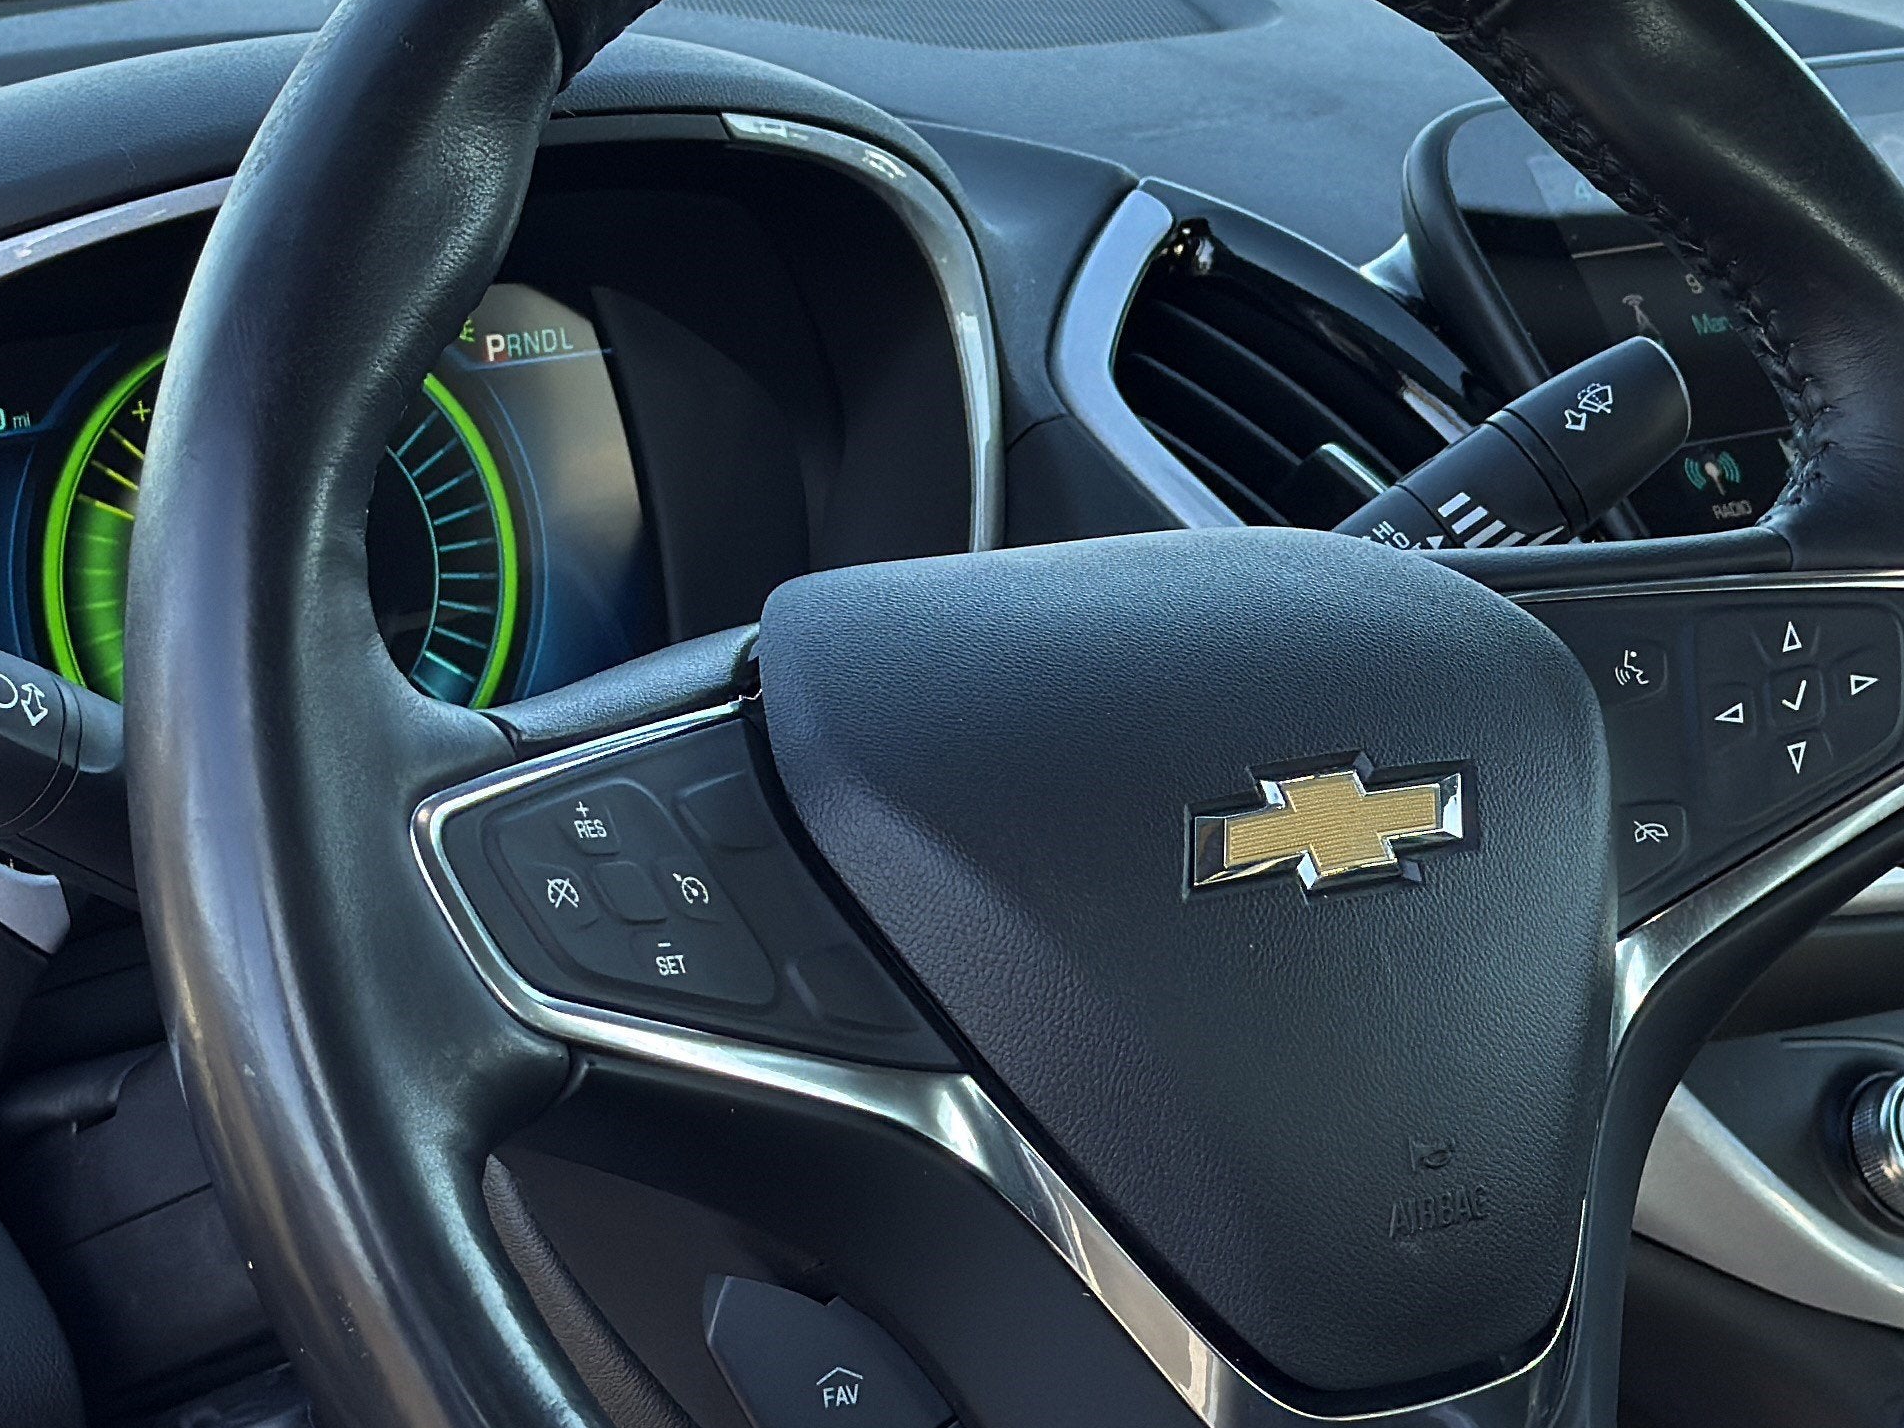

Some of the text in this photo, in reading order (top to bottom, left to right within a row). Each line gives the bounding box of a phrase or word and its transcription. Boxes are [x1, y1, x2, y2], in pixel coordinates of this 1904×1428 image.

[11, 411, 32, 430] mi
[573, 819, 608, 839] RES
[655, 954, 687, 977] SET
[822, 1383, 860, 1409] FAV
